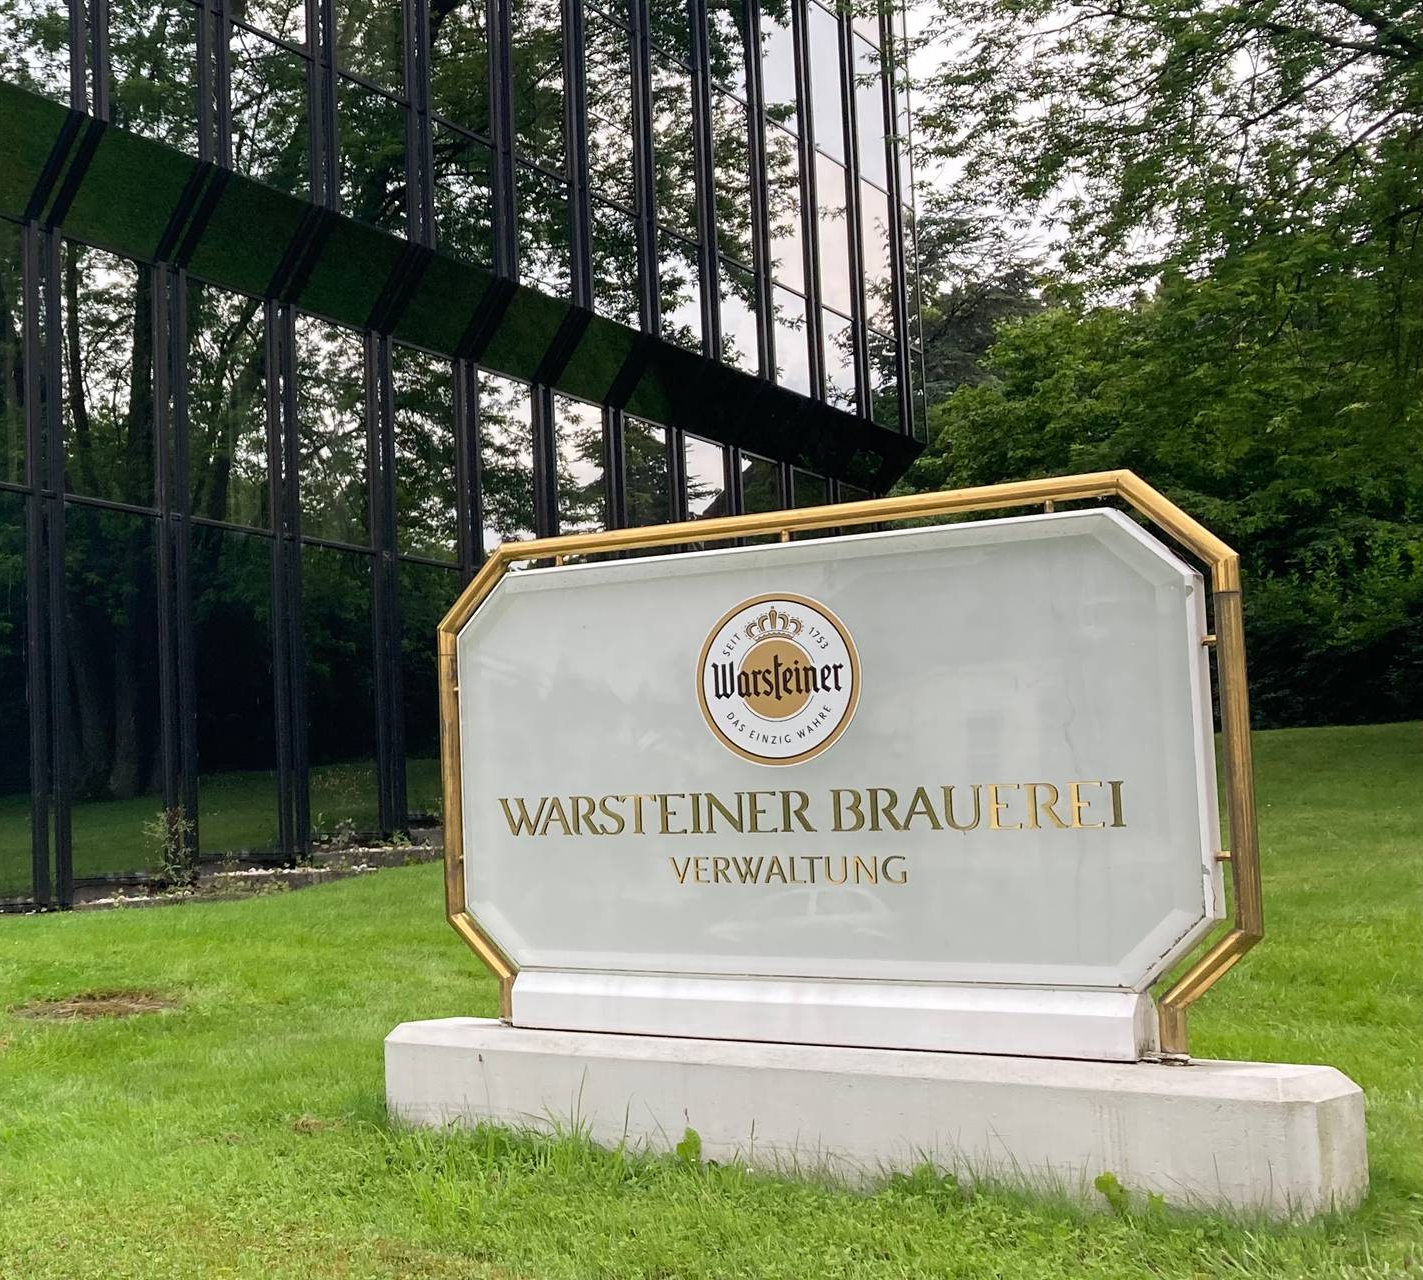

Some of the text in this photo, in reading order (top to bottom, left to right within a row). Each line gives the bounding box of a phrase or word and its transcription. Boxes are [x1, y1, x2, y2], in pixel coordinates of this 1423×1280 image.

[723, 627, 829, 656] SEIT 1753
[711, 655, 843, 701] Warsteiner
[727, 704, 832, 744] DAS EINZIG WAHRE
[498, 780, 1126, 836] WARSTEINER BRAUEREI
[669, 855, 907, 885] VERWALTUNG
